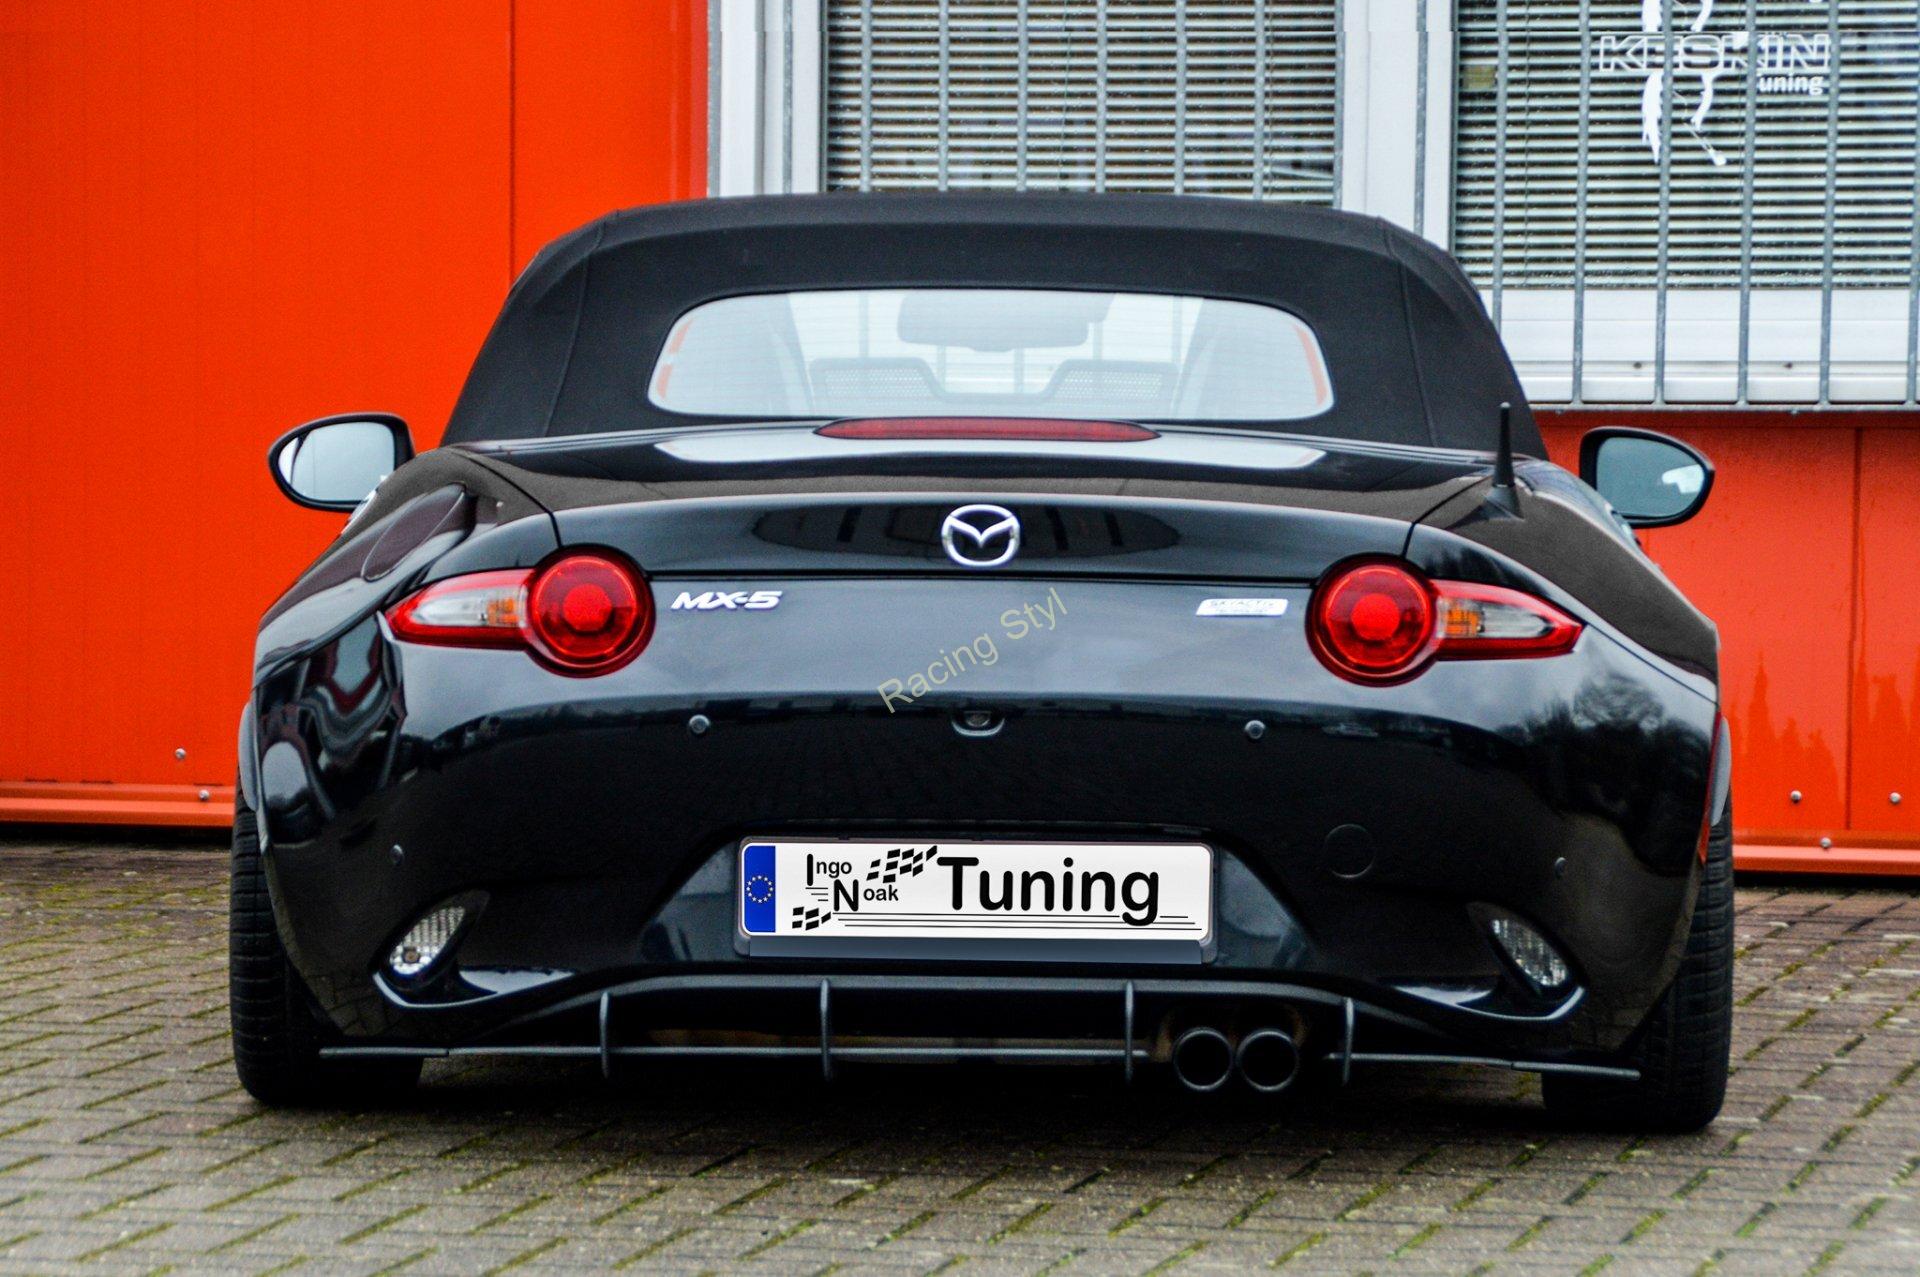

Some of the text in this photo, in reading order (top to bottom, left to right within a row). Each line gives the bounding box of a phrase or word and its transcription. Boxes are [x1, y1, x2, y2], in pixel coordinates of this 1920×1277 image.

[1752, 73, 1824, 96] uning
[671, 590, 783, 611] MX-5
[806, 853, 853, 887] Ingo
[833, 879, 899, 911] Noak
[936, 856, 1159, 926] Tuning
